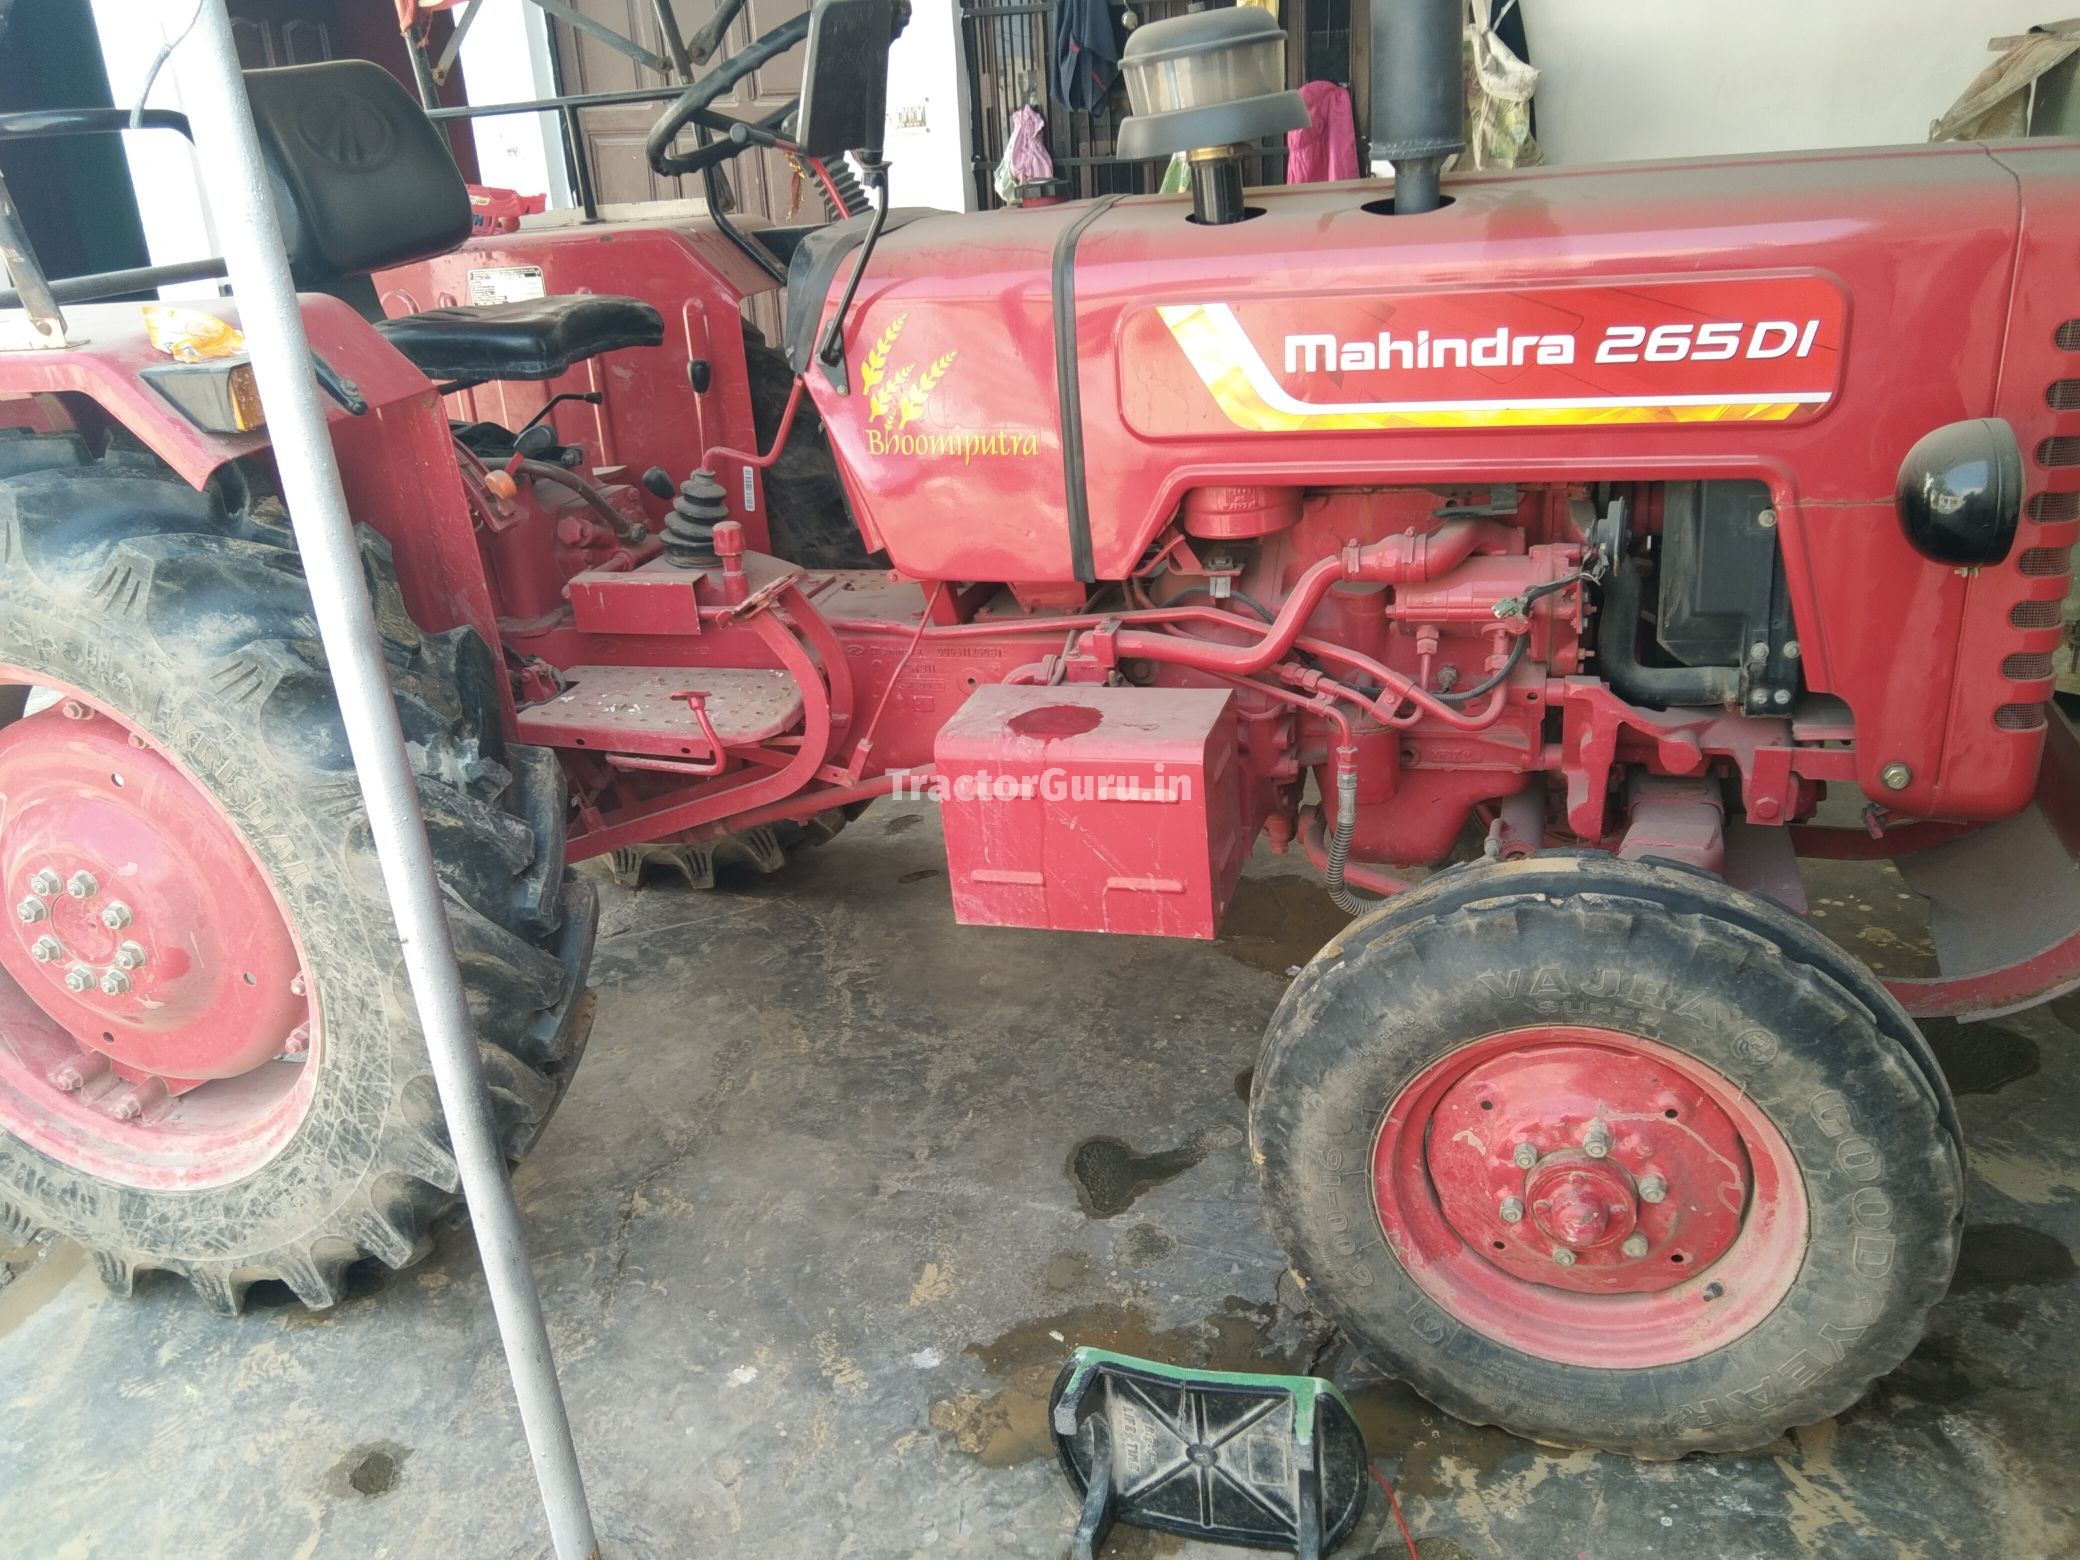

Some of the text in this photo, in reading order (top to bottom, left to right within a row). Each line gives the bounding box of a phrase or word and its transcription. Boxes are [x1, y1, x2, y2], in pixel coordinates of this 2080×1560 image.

[1284, 326, 1575, 374] Mahindra
[865, 428, 1040, 466] Bhoomiputra
[1477, 966, 1718, 1032] VAJRA
